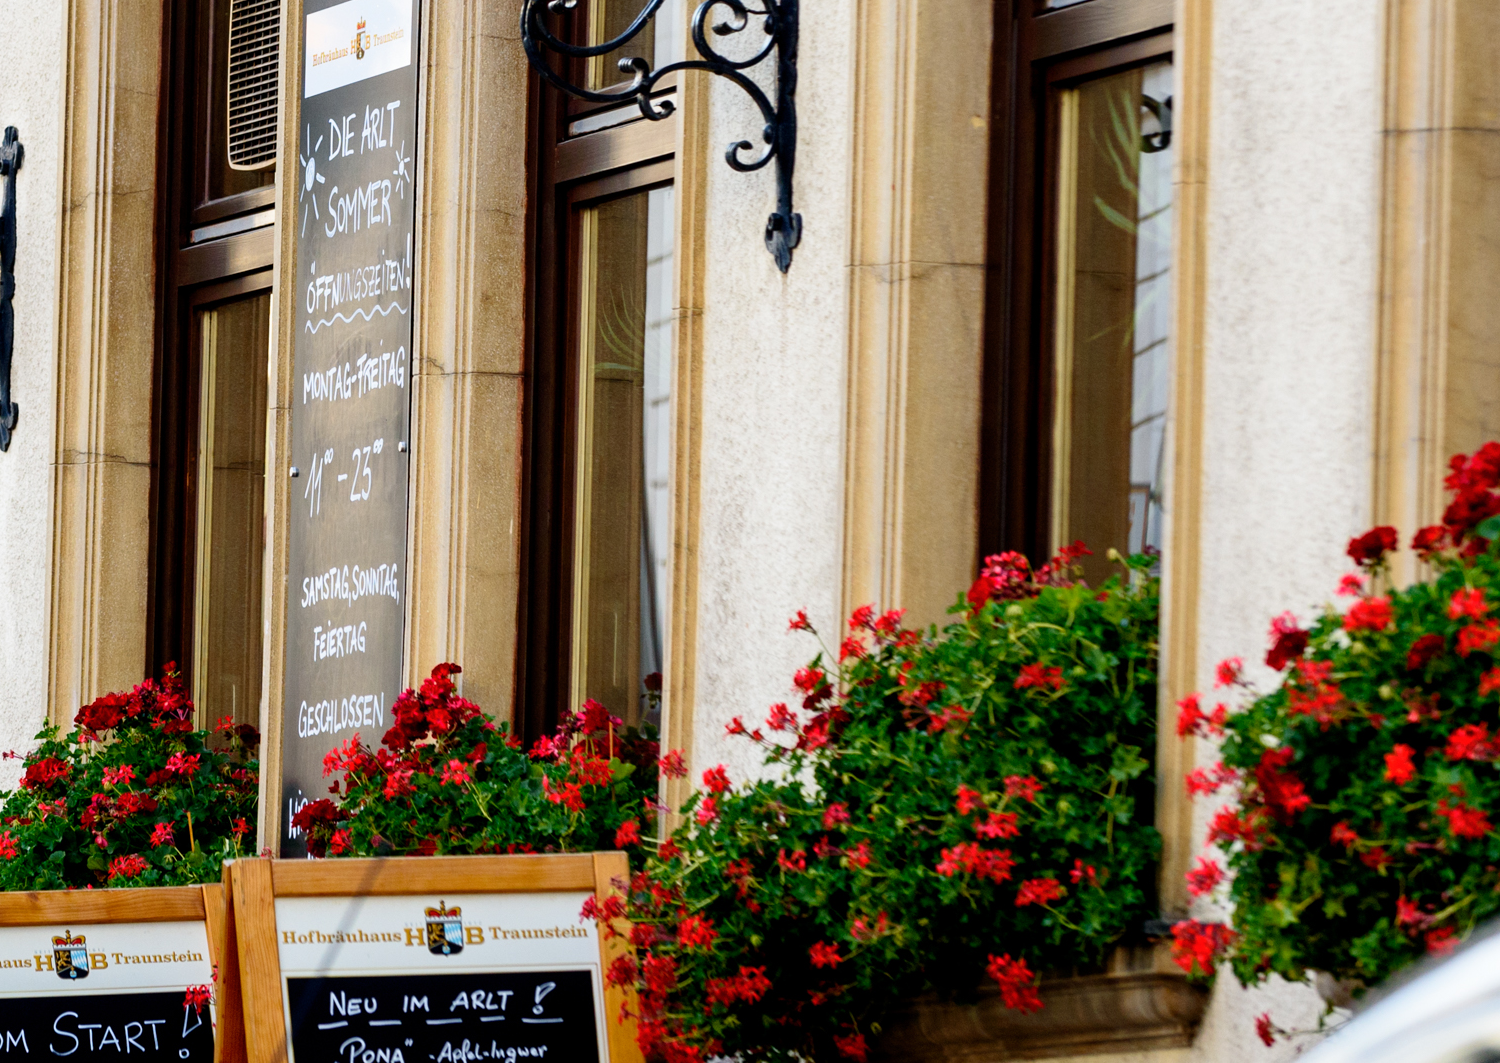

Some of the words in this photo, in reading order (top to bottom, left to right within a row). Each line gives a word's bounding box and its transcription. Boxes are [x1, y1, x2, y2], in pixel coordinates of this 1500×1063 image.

[328, 113, 355, 160] DIE
[361, 100, 400, 155] ARLT
[324, 179, 392, 239] SOMMER
[298, 691, 384, 738] GESCHLOSSEN
[282, 931, 402, 945] Hofbräuhaus
[488, 924, 589, 940] Traunstein
[111, 950, 204, 966] Traunstein
[329, 991, 377, 1016] NEU
[403, 995, 430, 1013] IM
[450, 990, 514, 1011] ARLT
[50, 1011, 166, 1056] START
